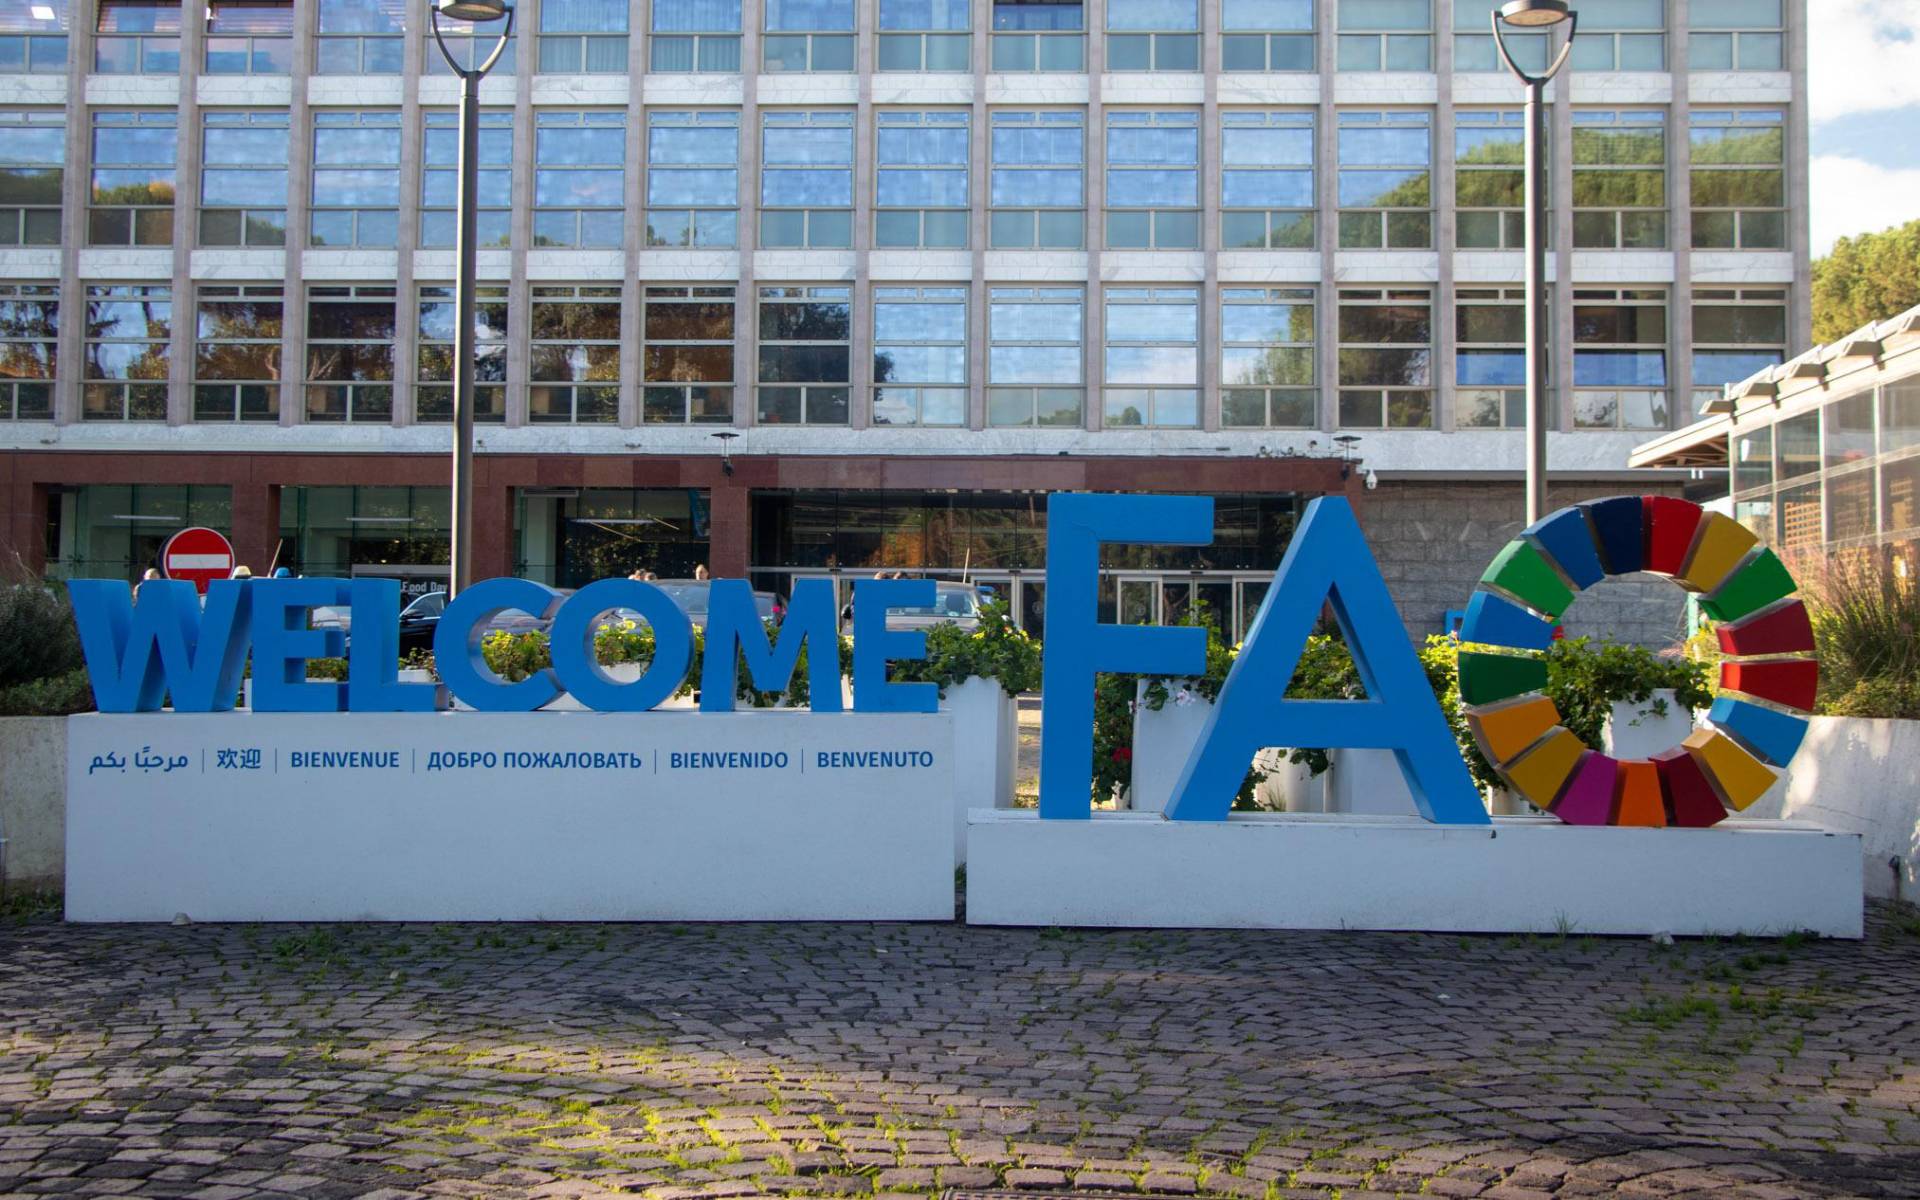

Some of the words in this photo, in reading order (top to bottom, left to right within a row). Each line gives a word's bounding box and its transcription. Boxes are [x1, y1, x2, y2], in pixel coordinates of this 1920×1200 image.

[67, 576, 938, 713] WELCOME
[88, 751, 127, 776] بكم
[217, 748, 262, 770] 欢迎
[290, 751, 400, 769] BIENVENUE
[427, 751, 497, 772] ДОБРО
[503, 751, 642, 769] ПОЖАЛОВАТЬ
[670, 751, 789, 769] BIENVENIDO
[817, 751, 934, 769] BENVENUTO
